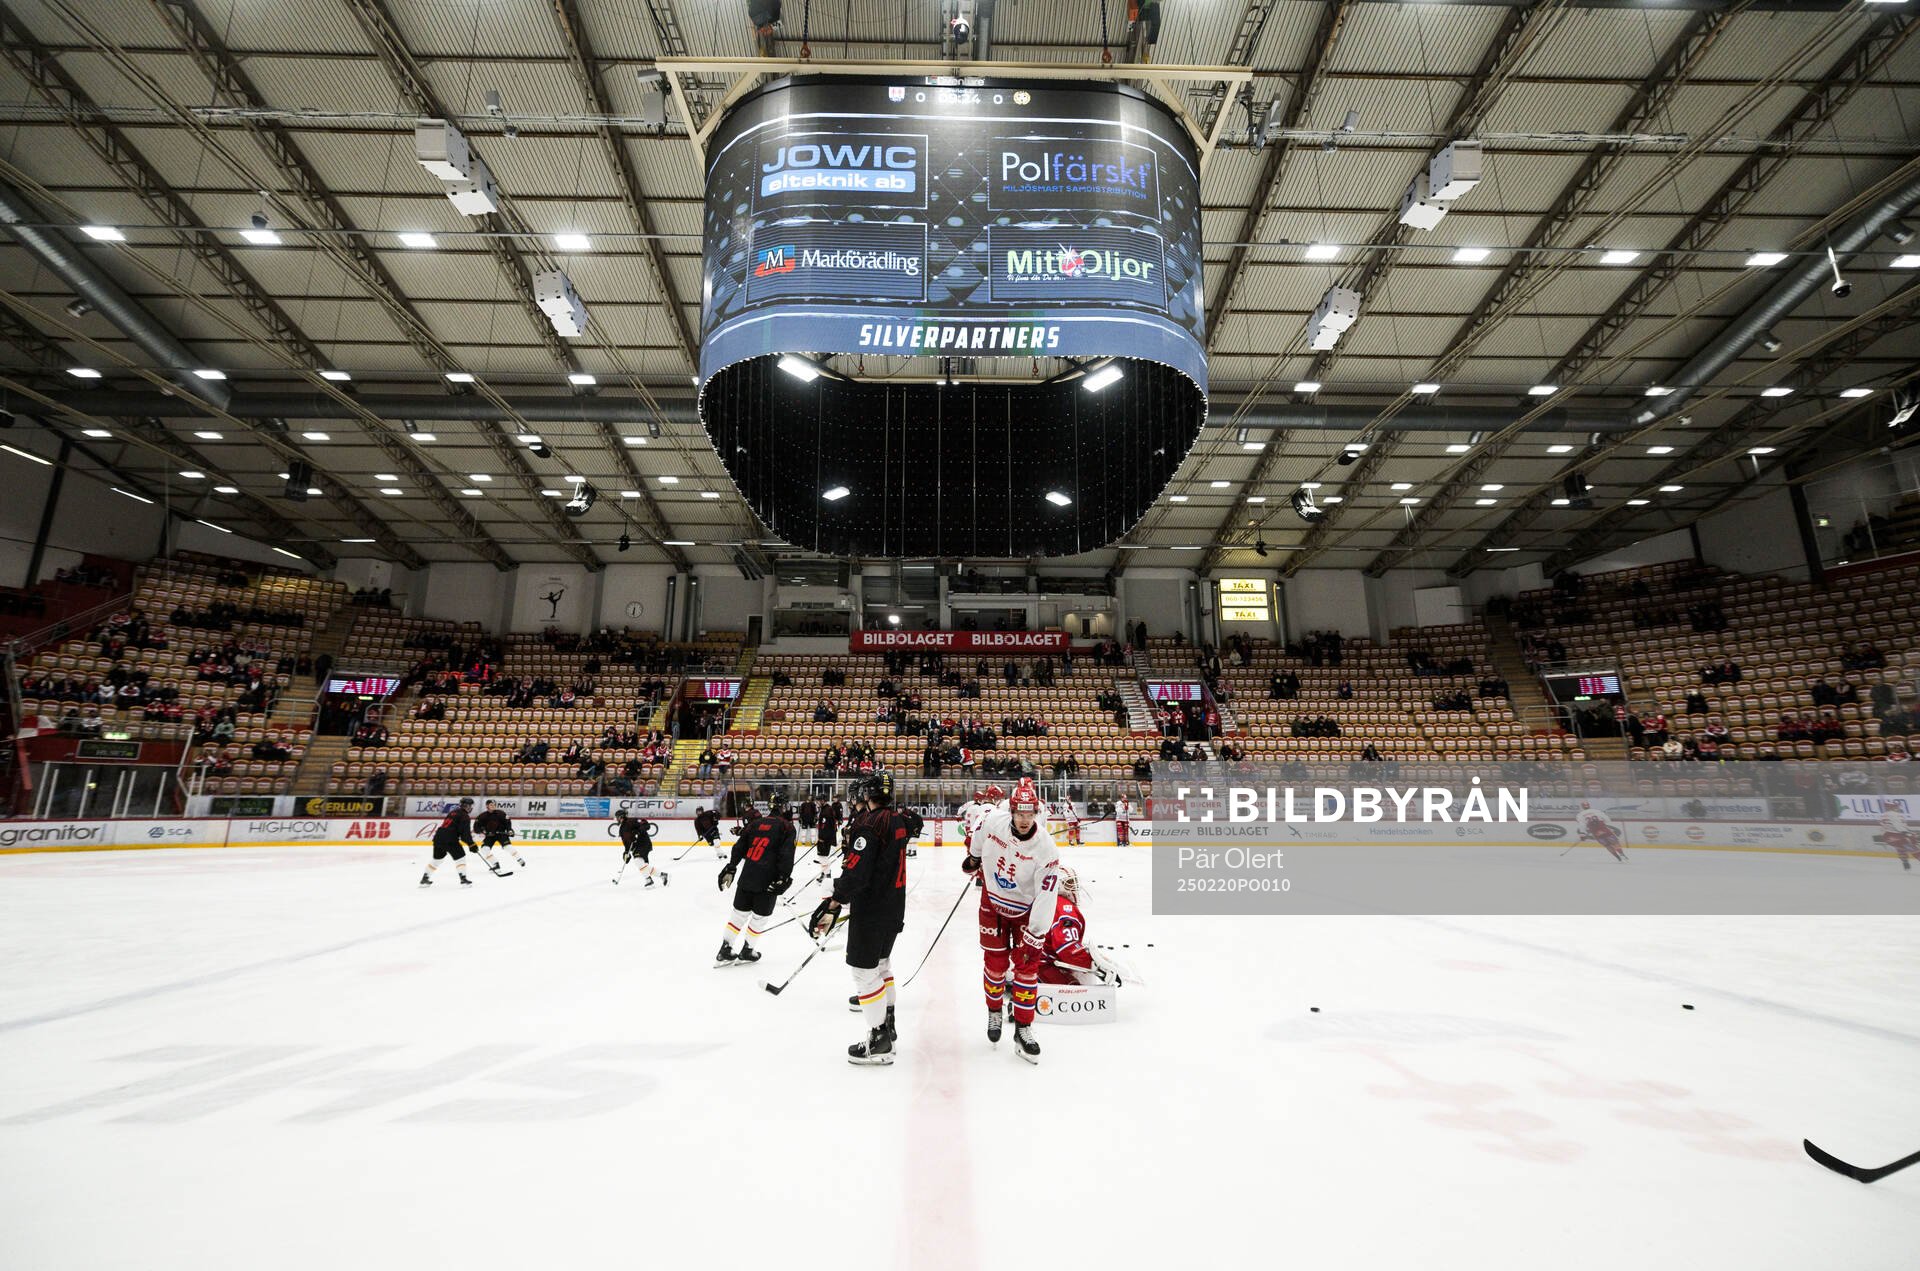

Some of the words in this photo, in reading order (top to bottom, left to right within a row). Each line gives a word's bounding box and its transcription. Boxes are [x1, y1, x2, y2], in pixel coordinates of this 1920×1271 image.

[762, 144, 917, 173] JOWIC
[1002, 152, 1151, 189] Polfärskt
[769, 172, 867, 191] elteknik
[874, 174, 907, 190] ab
[1002, 184, 1065, 193] MILJÖSMART
[1065, 185, 1148, 200] SAMDISTRIBUTION
[801, 249, 920, 276] Markförädling
[859, 323, 1060, 349] SILVERPARTNERS
[863, 633, 954, 645] BILBOLAGET
[972, 633, 1062, 646] BILBOLAGET
[528, 801, 547, 812] HH
[168, 828, 193, 837] SCA
[249, 821, 328, 833] HIGHCON
[345, 821, 391, 839] ABB
[520, 829, 577, 840] TIRAB
[1197, 826, 1269, 837] BILBOLAGET
[1369, 827, 1433, 836] Handelsbanken
[0, 824, 101, 846] granitor
[1062, 927, 1080, 942] 30
[1058, 999, 1107, 1014] COOR
